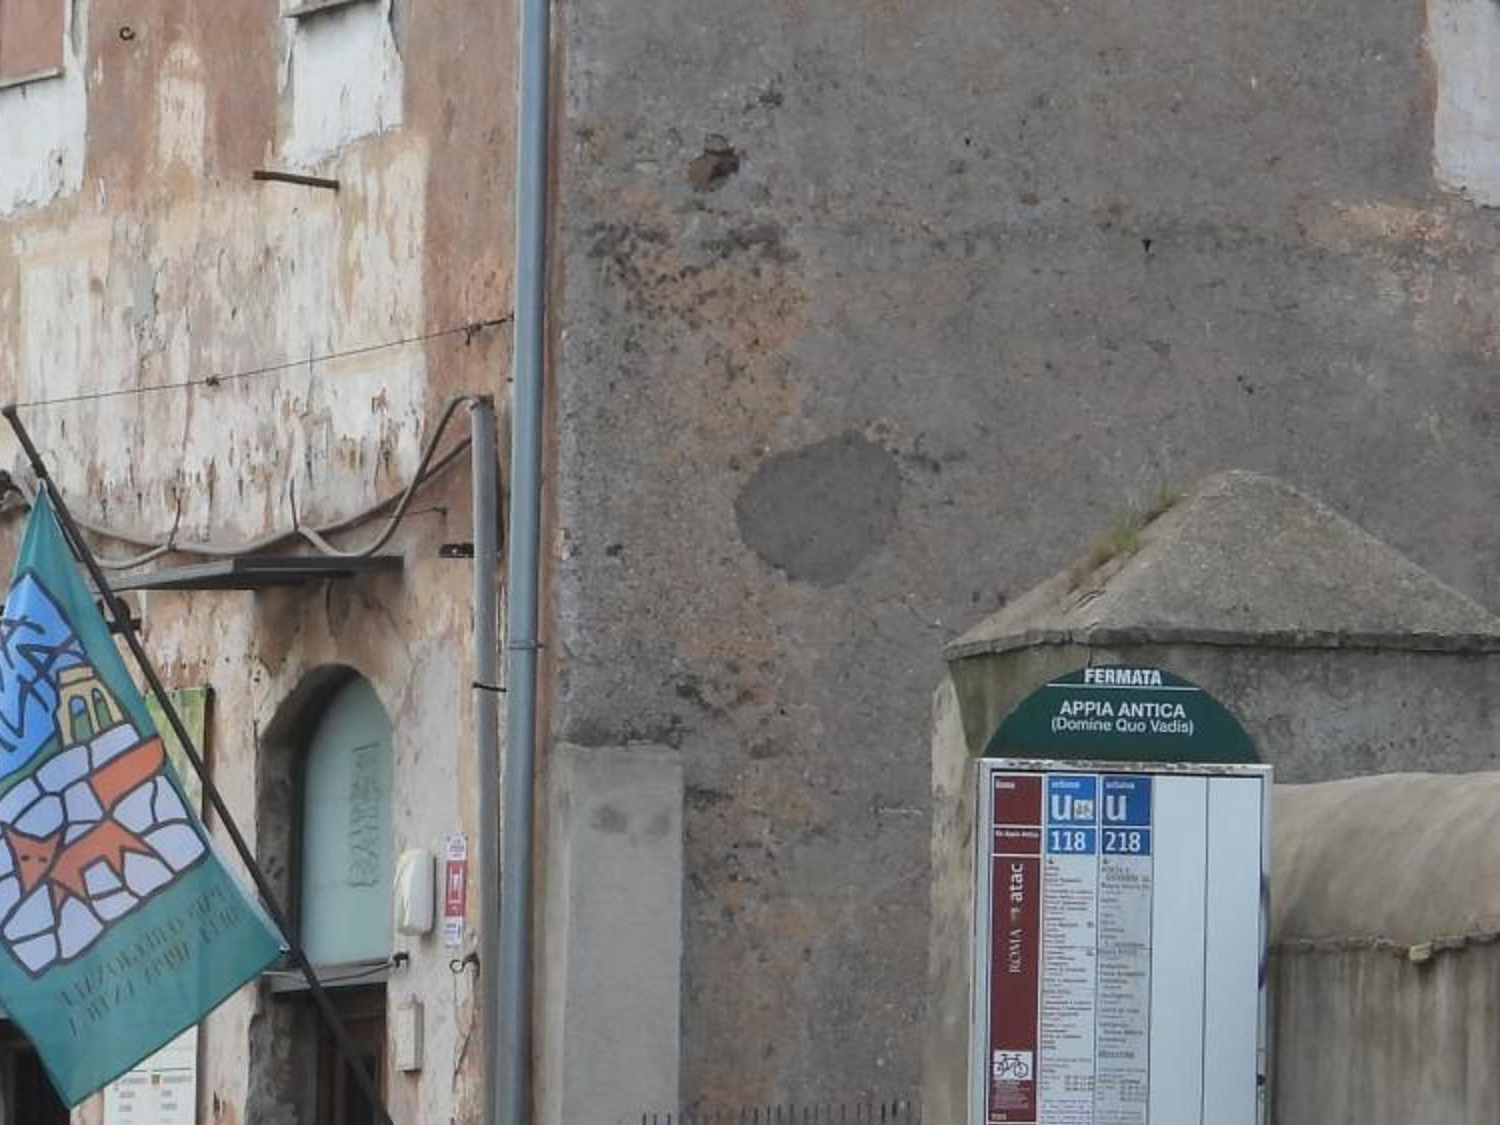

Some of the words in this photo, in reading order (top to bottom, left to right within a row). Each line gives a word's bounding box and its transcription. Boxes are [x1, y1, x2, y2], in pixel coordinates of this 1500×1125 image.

[1084, 669, 1163, 686] FERMATA
[1059, 700, 1115, 717] APPIA
[1117, 702, 1187, 719] ANTICA
[1051, 717, 1112, 733] (Domine
[1115, 717, 1146, 733] Quo
[1150, 719, 1195, 737] Vadis)
[1051, 830, 1086, 851] 118
[1105, 831, 1141, 852] 218
[1009, 863, 1025, 903] atac
[1009, 928, 1023, 973] ROMA
